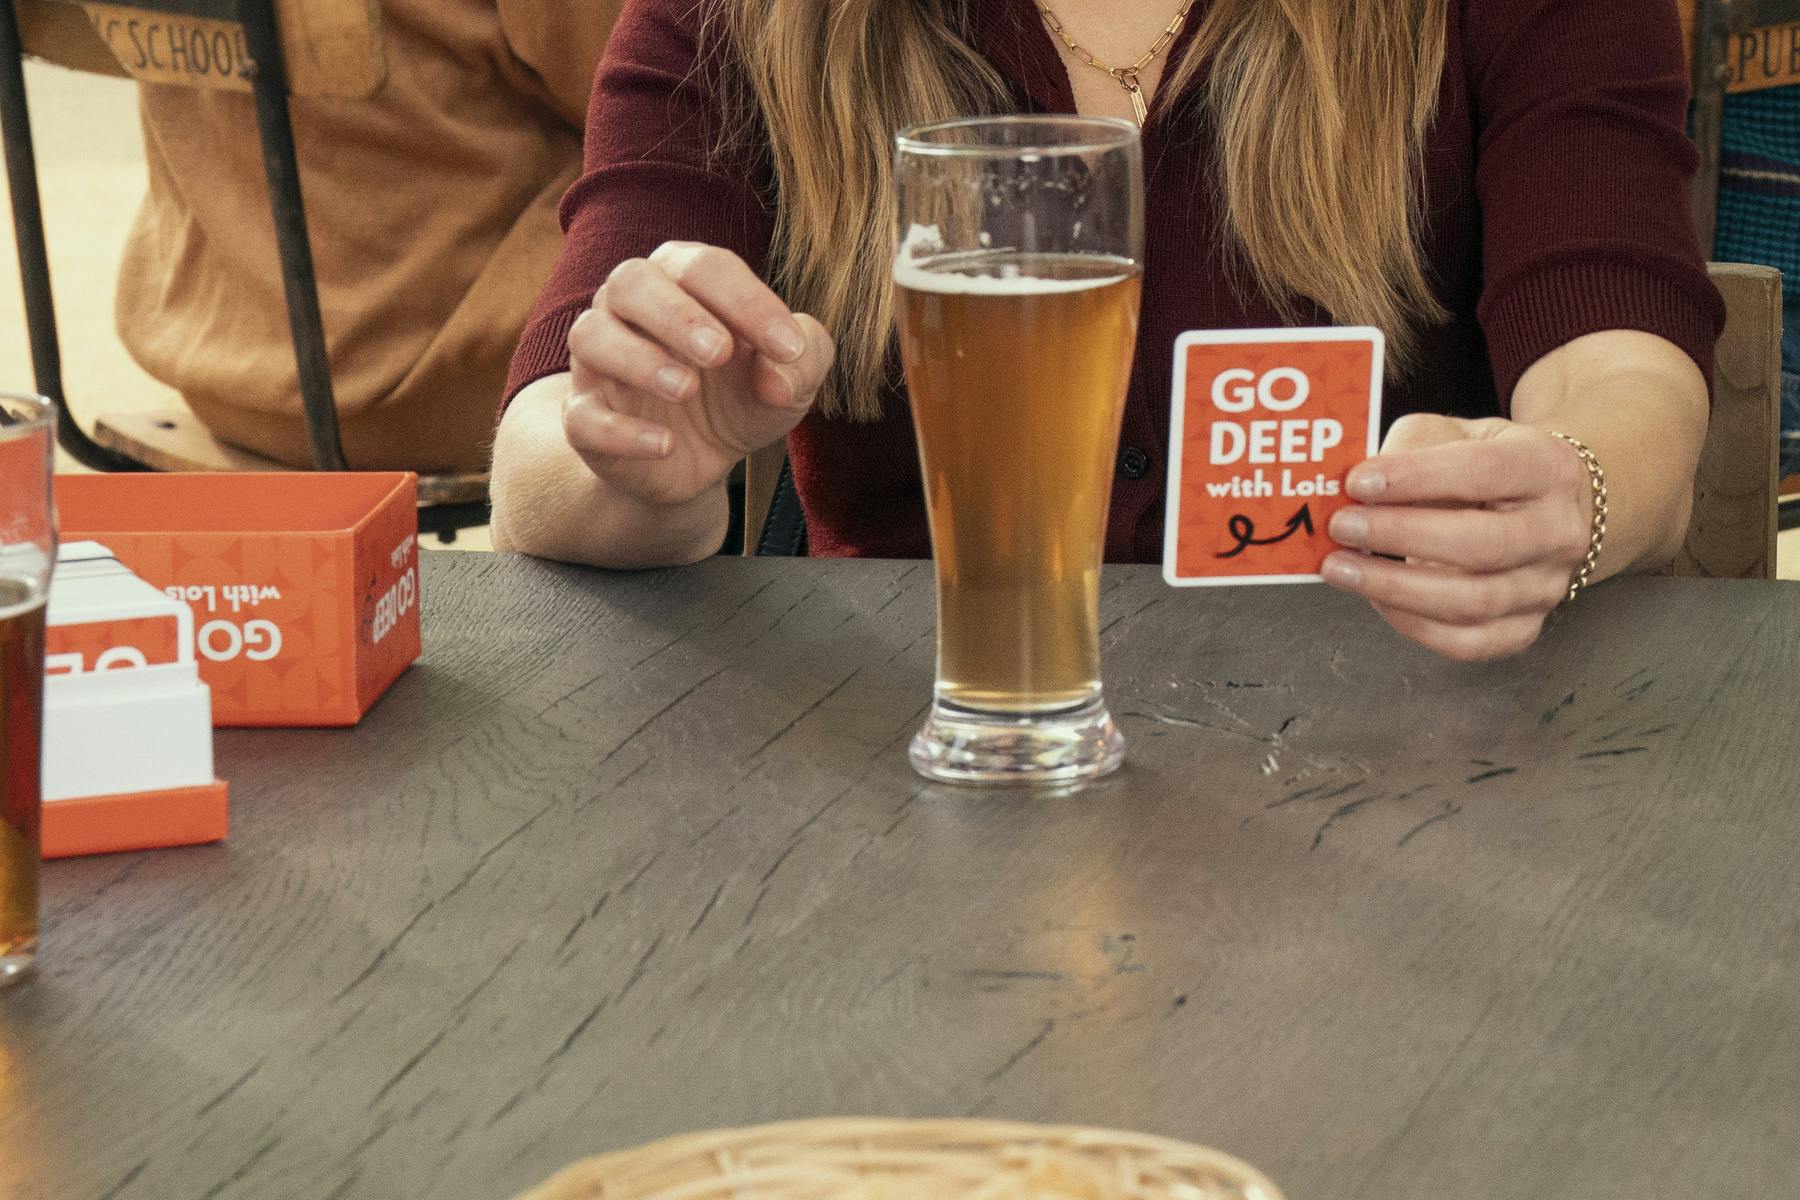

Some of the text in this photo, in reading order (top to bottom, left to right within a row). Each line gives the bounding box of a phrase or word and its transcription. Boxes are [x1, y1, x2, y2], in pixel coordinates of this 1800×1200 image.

[1210, 366, 1311, 413] GO
[1209, 417, 1344, 466] DEEP
[1205, 468, 1341, 498] with Lois
[222, 584, 282, 613] with
[197, 618, 283, 662] GO
